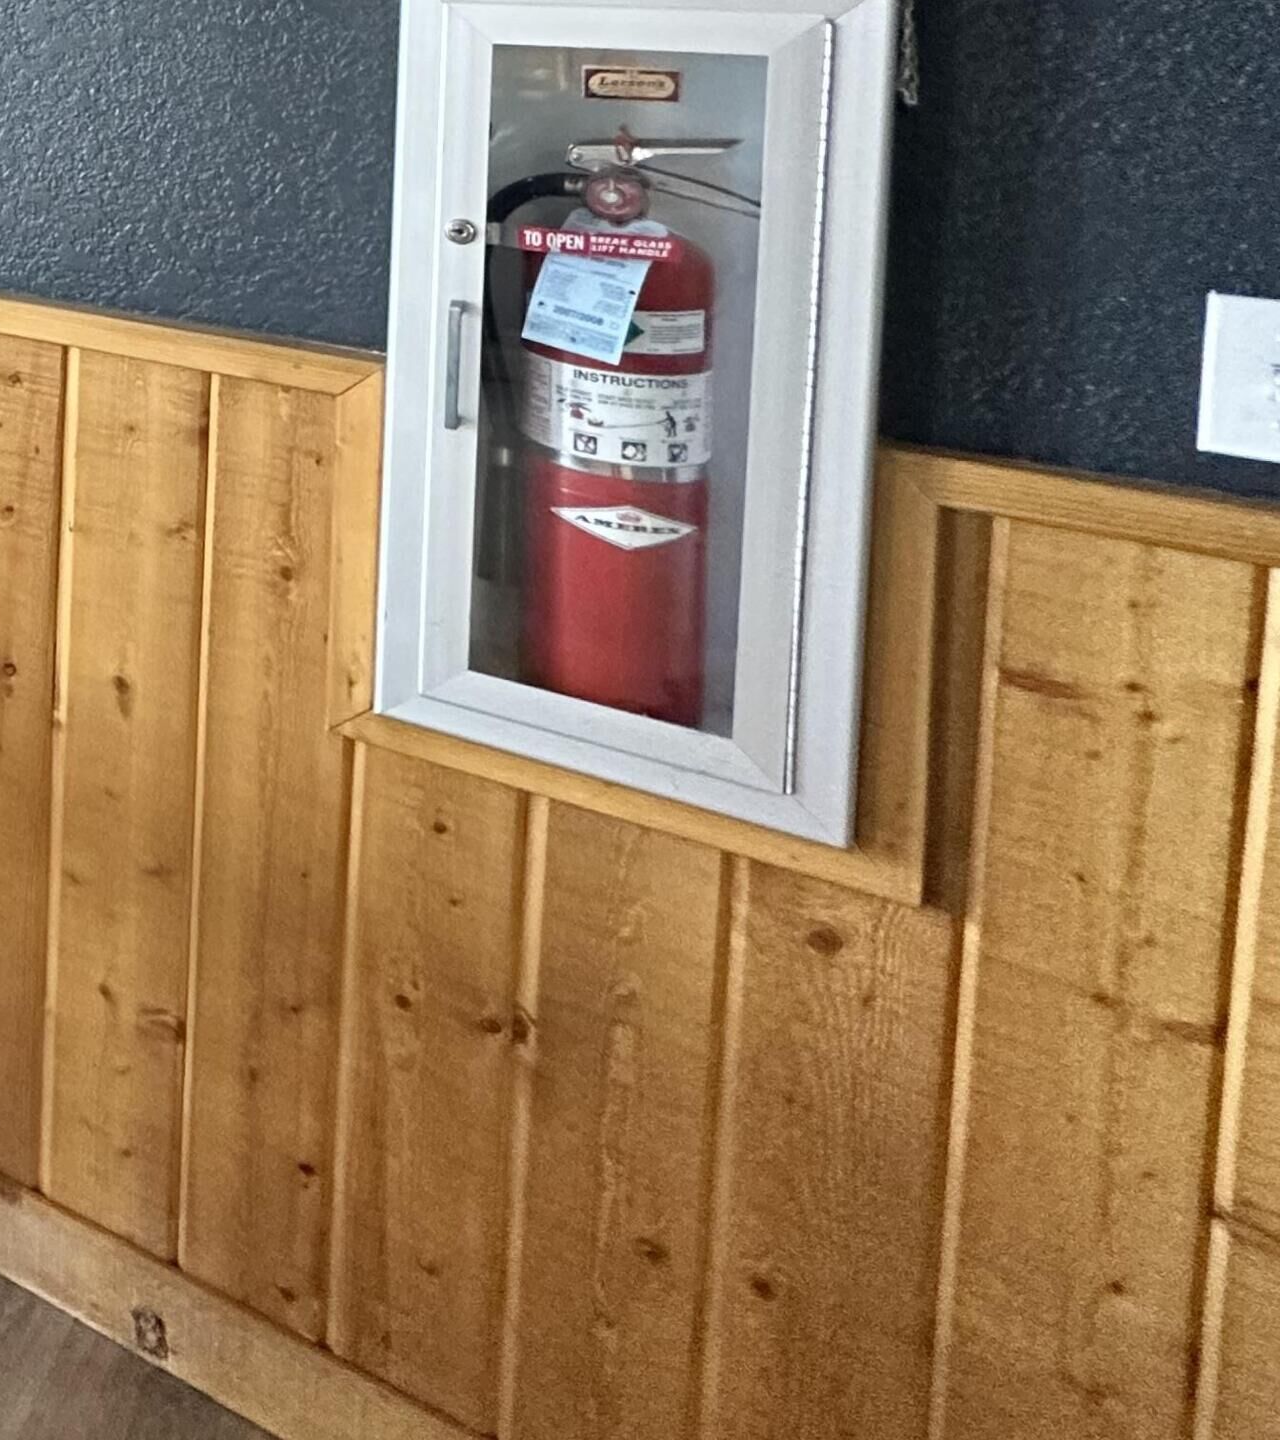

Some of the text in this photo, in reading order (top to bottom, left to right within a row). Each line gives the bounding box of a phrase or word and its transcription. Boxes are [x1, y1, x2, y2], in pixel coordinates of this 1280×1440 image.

[523, 230, 585, 250] TO OPEN
[590, 236, 672, 250] BREAK GLASS
[591, 244, 668, 257] LIFT HANDLE
[573, 369, 689, 389] INSTRUCTIONS
[575, 514, 681, 534] AMEREX
